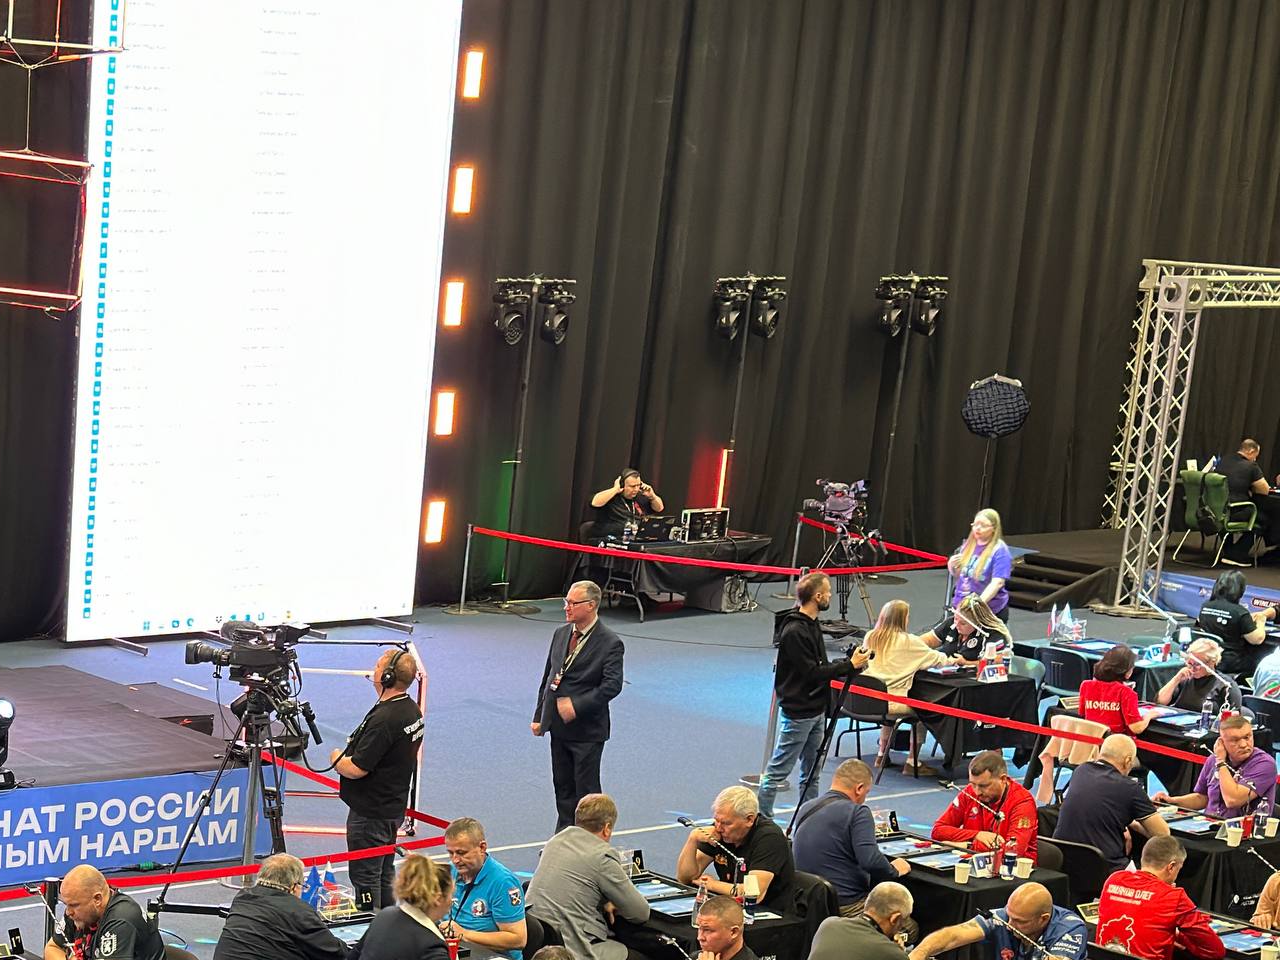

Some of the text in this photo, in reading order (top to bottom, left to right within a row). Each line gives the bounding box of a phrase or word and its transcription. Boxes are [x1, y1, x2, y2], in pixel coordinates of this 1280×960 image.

[74, 786, 240, 830] РОССИИ
[81, 818, 238, 861] НАРДАМ
[361, 892, 372, 904] 13
